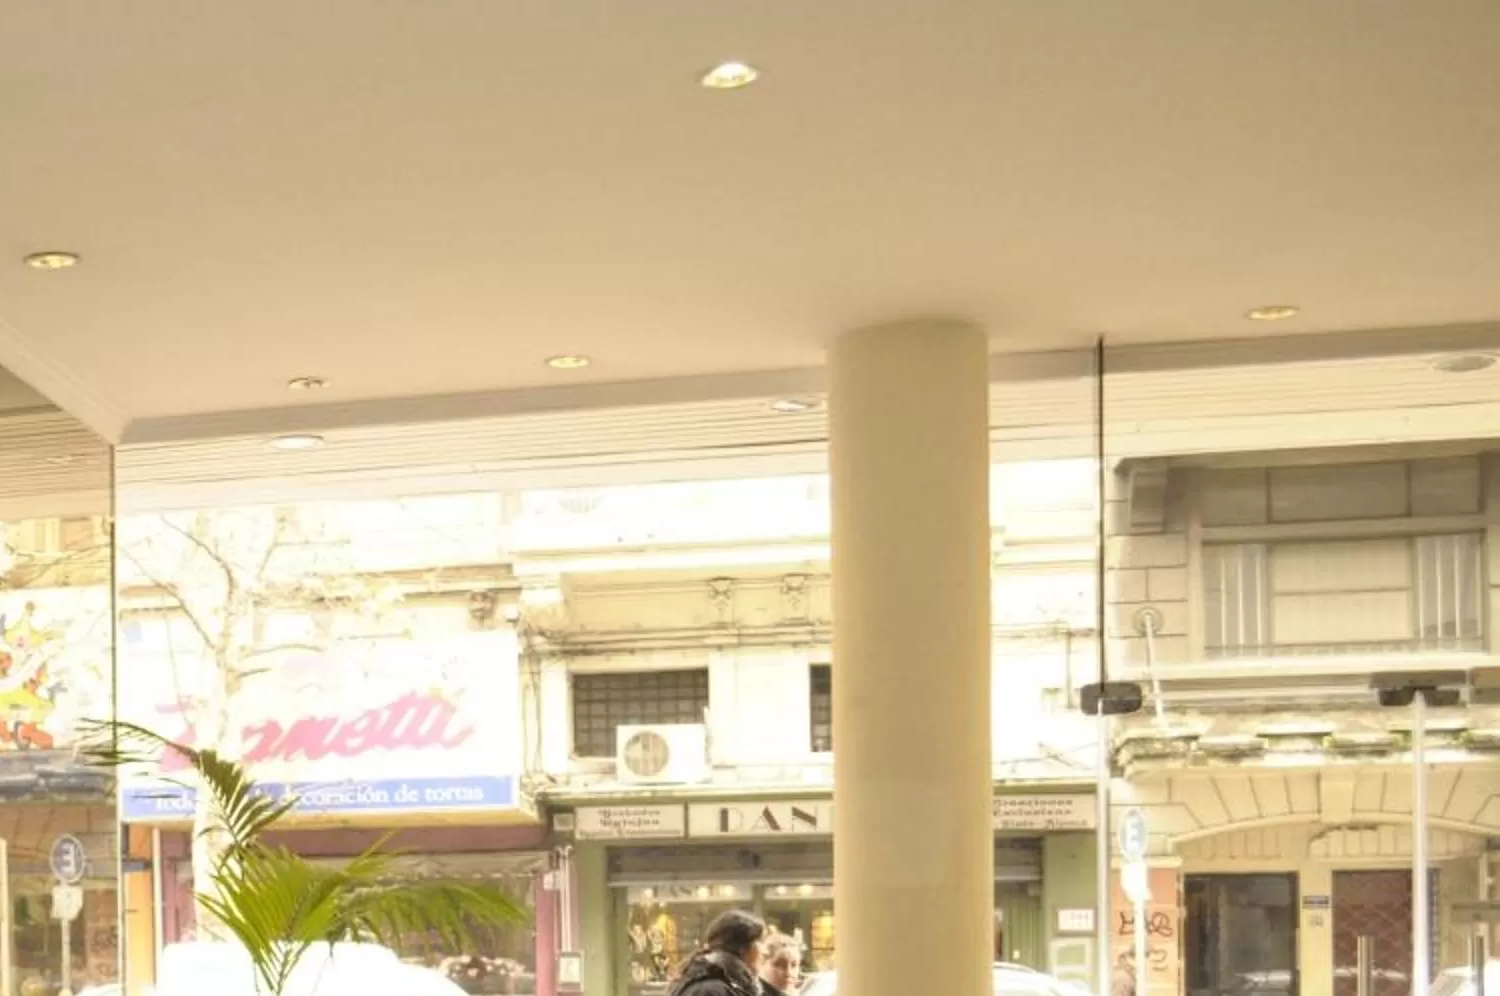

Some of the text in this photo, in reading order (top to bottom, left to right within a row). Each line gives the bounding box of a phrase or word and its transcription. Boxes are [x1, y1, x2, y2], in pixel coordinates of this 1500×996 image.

[394, 784, 419, 803] de
[425, 785, 484, 803] tortas
[1125, 815, 1141, 849] E
